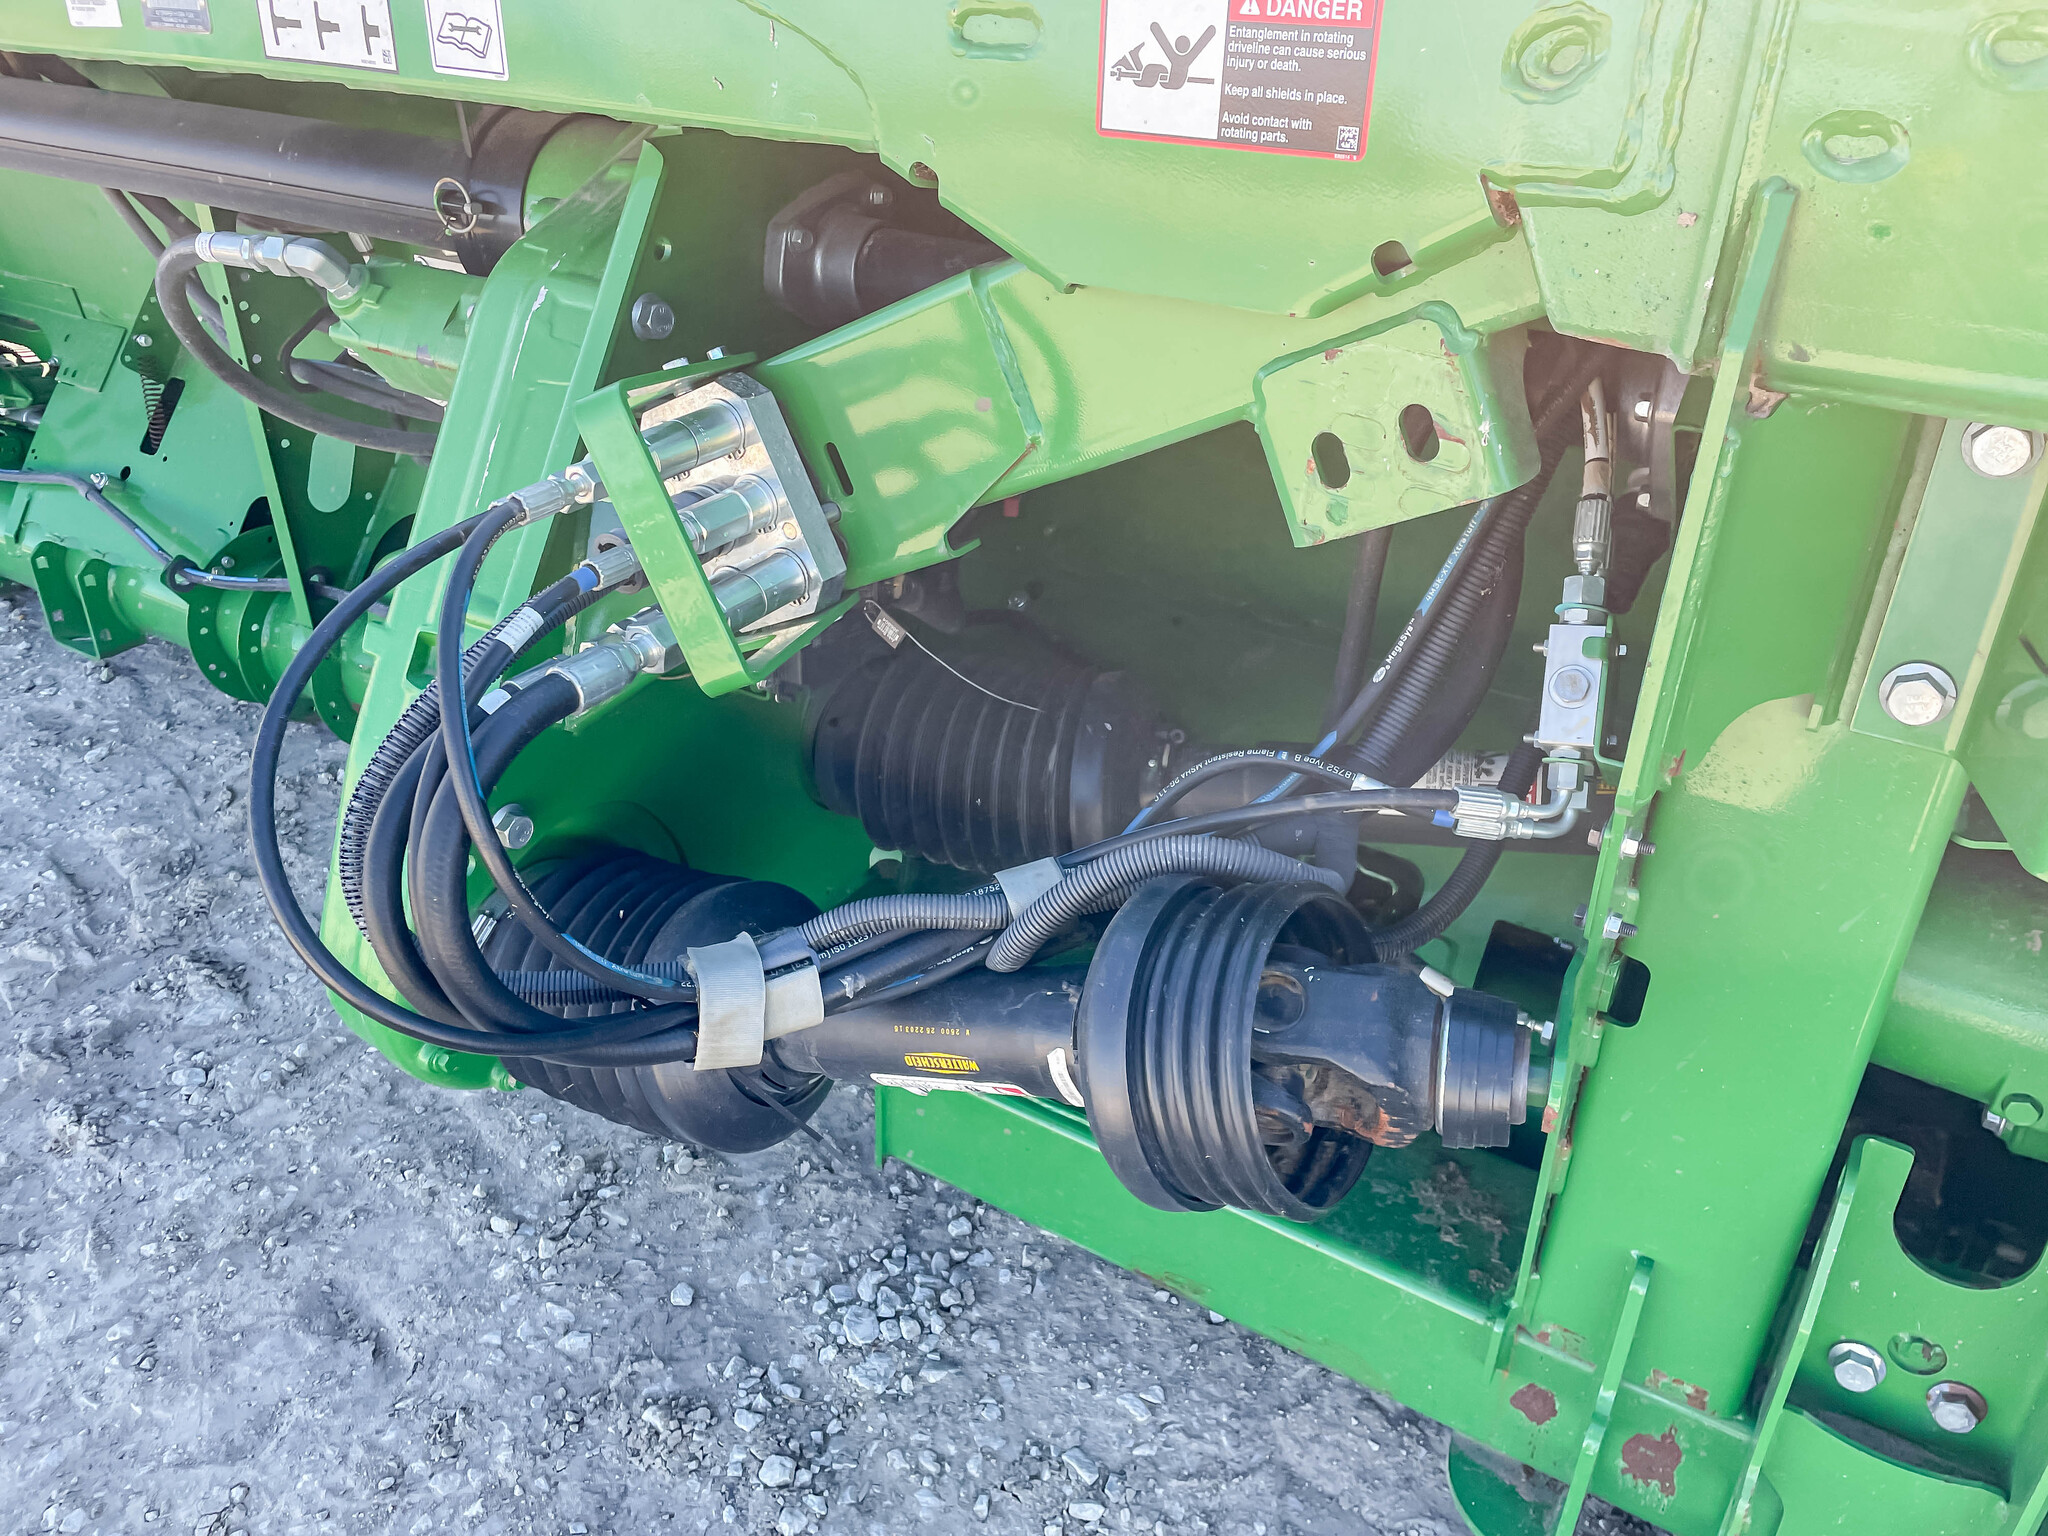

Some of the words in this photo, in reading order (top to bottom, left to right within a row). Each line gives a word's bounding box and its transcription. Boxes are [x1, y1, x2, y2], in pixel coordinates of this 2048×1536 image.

[1266, 0, 1363, 21] DANGER
[1229, 25, 1298, 41] Entanglement
[1301, 29, 1310, 42] in
[1313, 31, 1354, 47] rotating
[1228, 41, 1270, 54] driveline
[1273, 46, 1291, 56] can
[1294, 47, 1324, 58] cause
[1327, 48, 1366, 61] serious
[1227, 55, 1255, 71] injury
[1257, 59, 1268, 70] or
[1270, 58, 1301, 72] death.
[1224, 83, 1250, 99] Keep
[1251, 85, 1264, 97] all
[1266, 86, 1301, 101] shields
[1304, 89, 1314, 101] in
[1317, 91, 1348, 105] place.
[1222, 111, 1249, 124] Avoid
[1252, 115, 1289, 129] contact
[1291, 117, 1313, 130] with
[1221, 127, 1258, 143] rotating
[1261, 130, 1289, 143] parts.
[1206, 750, 1244, 766] Resistant
[1247, 750, 1275, 758] Flame
[1294, 753, 1302, 762] B
[1303, 756, 1329, 769] Type
[1181, 762, 1203, 779] MSHA
[831, 943, 846, 954] ISO
[904, 1055, 980, 1072] WALTERSCHEID
